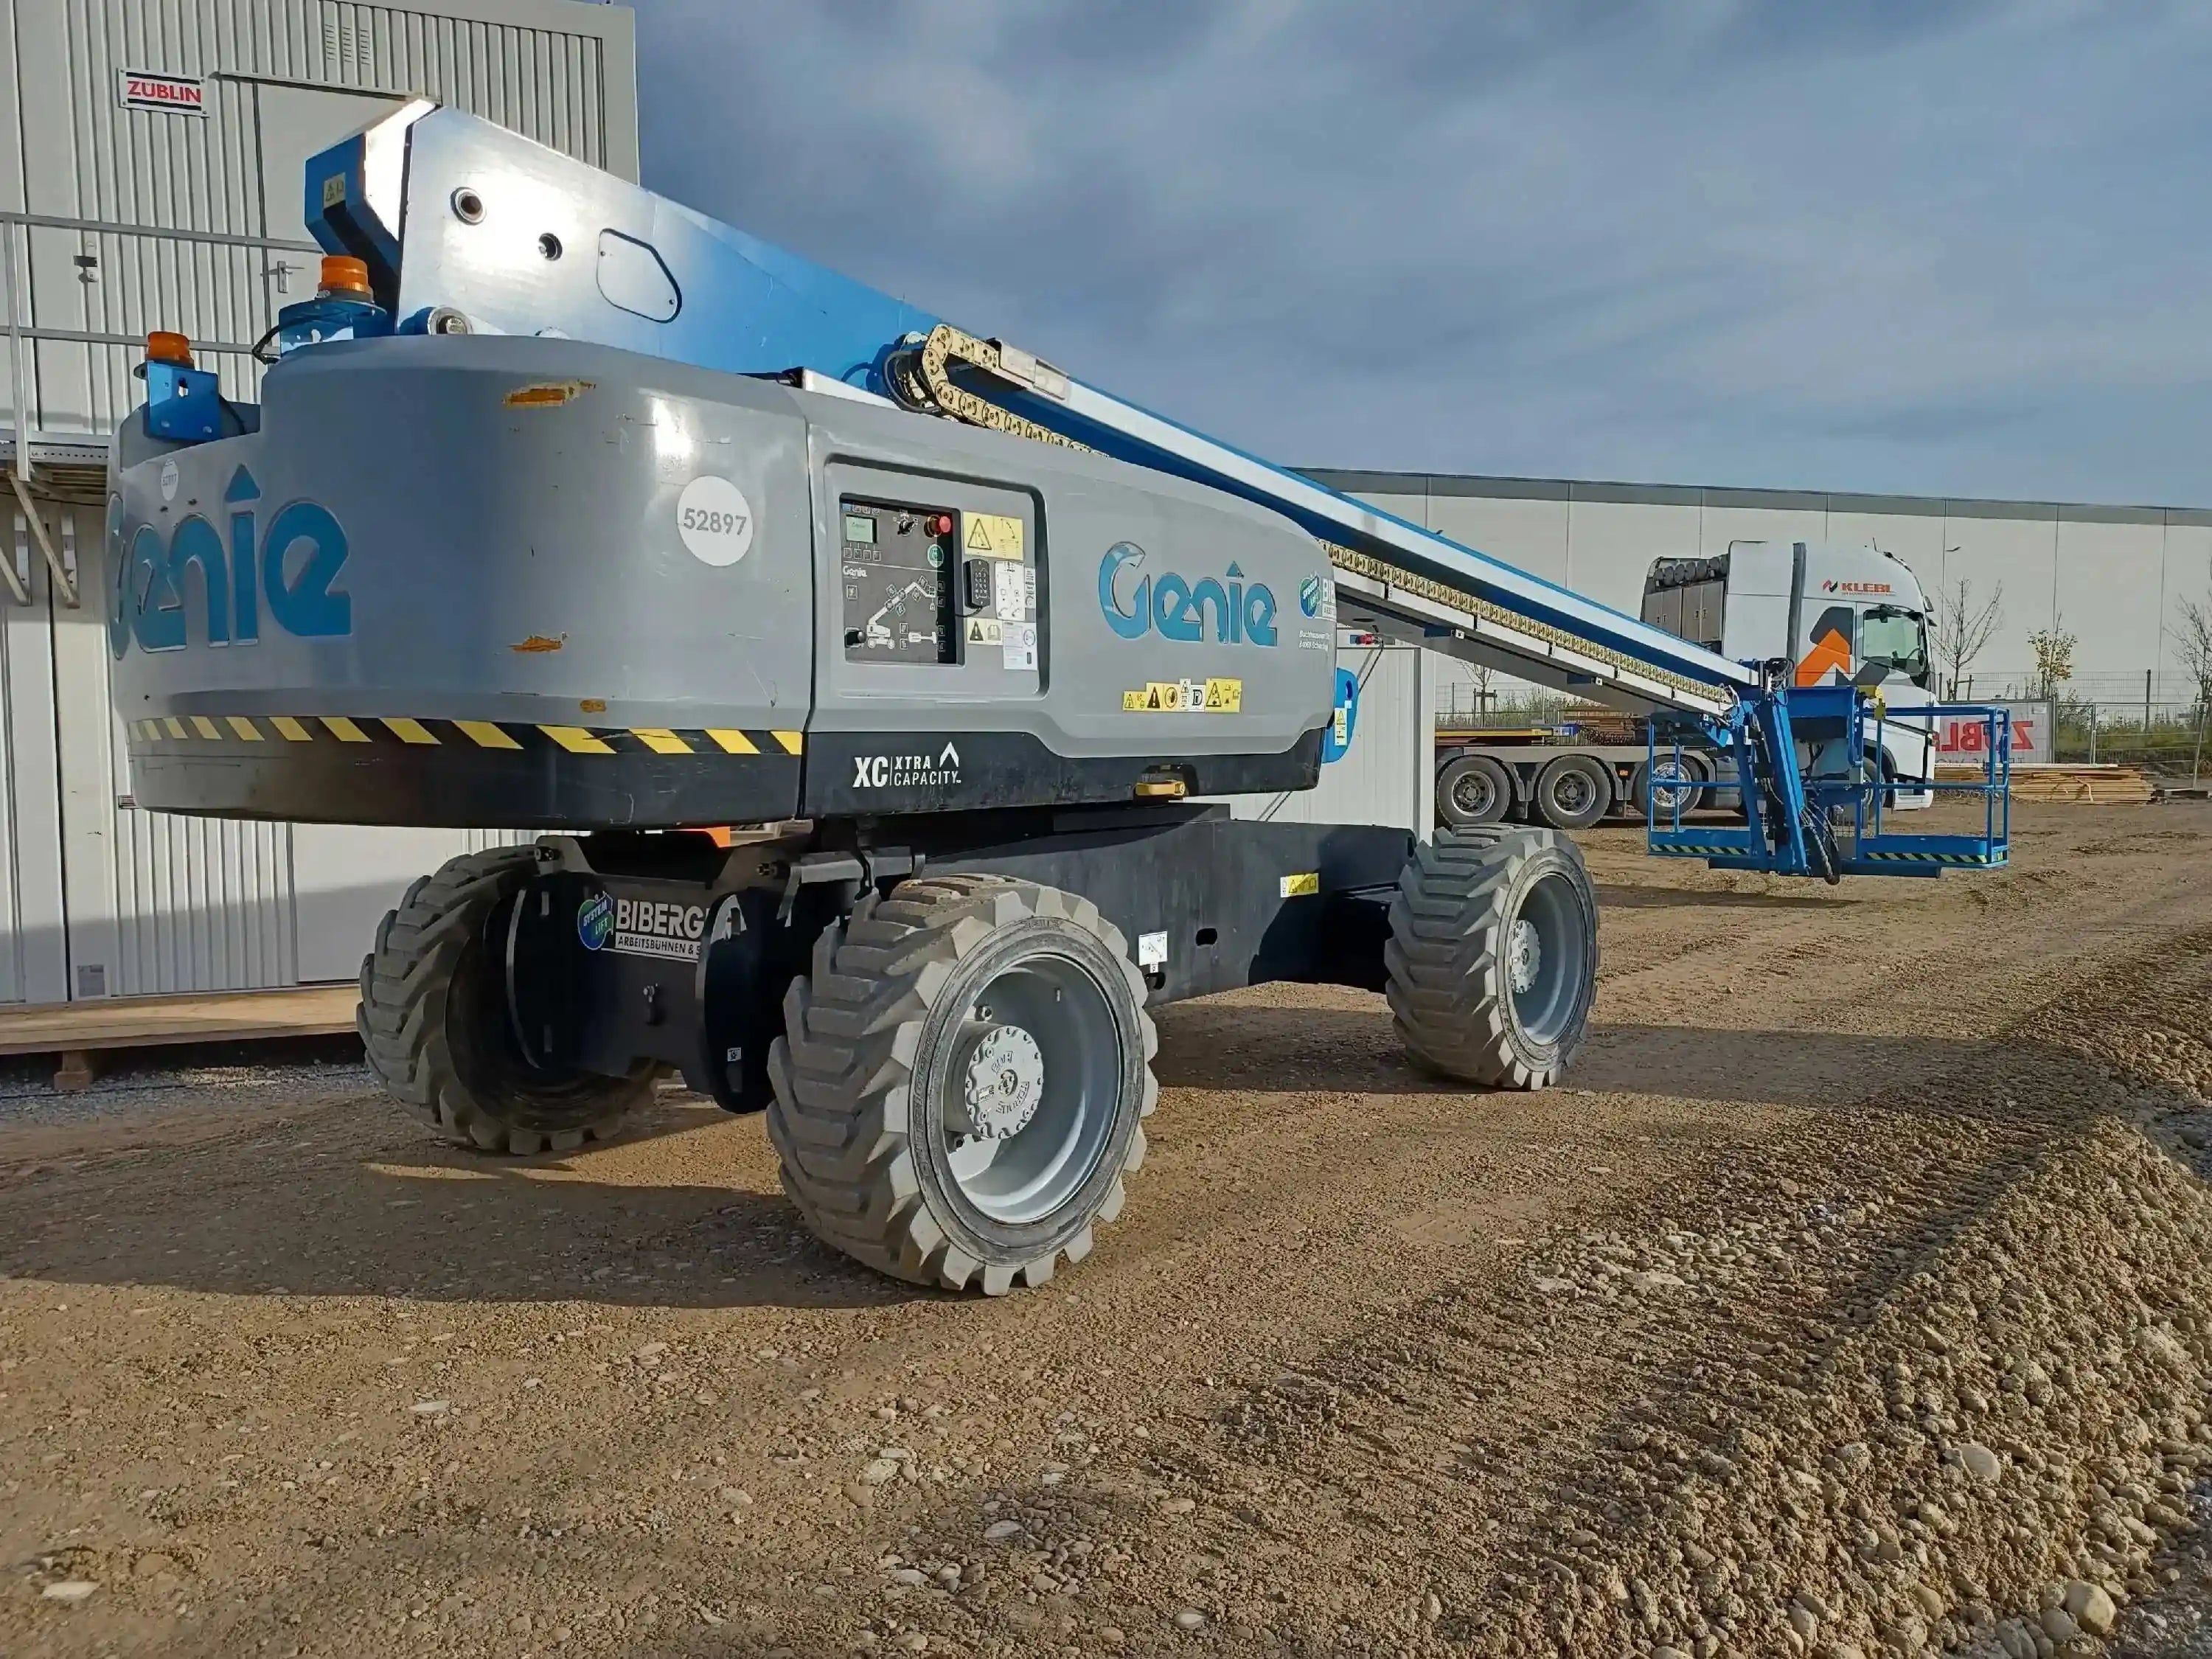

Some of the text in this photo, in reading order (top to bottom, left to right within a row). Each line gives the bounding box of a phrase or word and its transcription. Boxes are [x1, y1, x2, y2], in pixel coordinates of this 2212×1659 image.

[683, 507, 747, 535] 52897
[1098, 540, 1278, 647] Genie
[852, 756, 888, 788] XC
[894, 755, 931, 770] XTRA
[894, 771, 959, 787] CAPACITY
[583, 899, 608, 928] SYSTEM
[595, 917, 608, 935] LIFT
[616, 899, 710, 939] BIBERG
[618, 935, 686, 954] ARBEITSBÜHNEN
